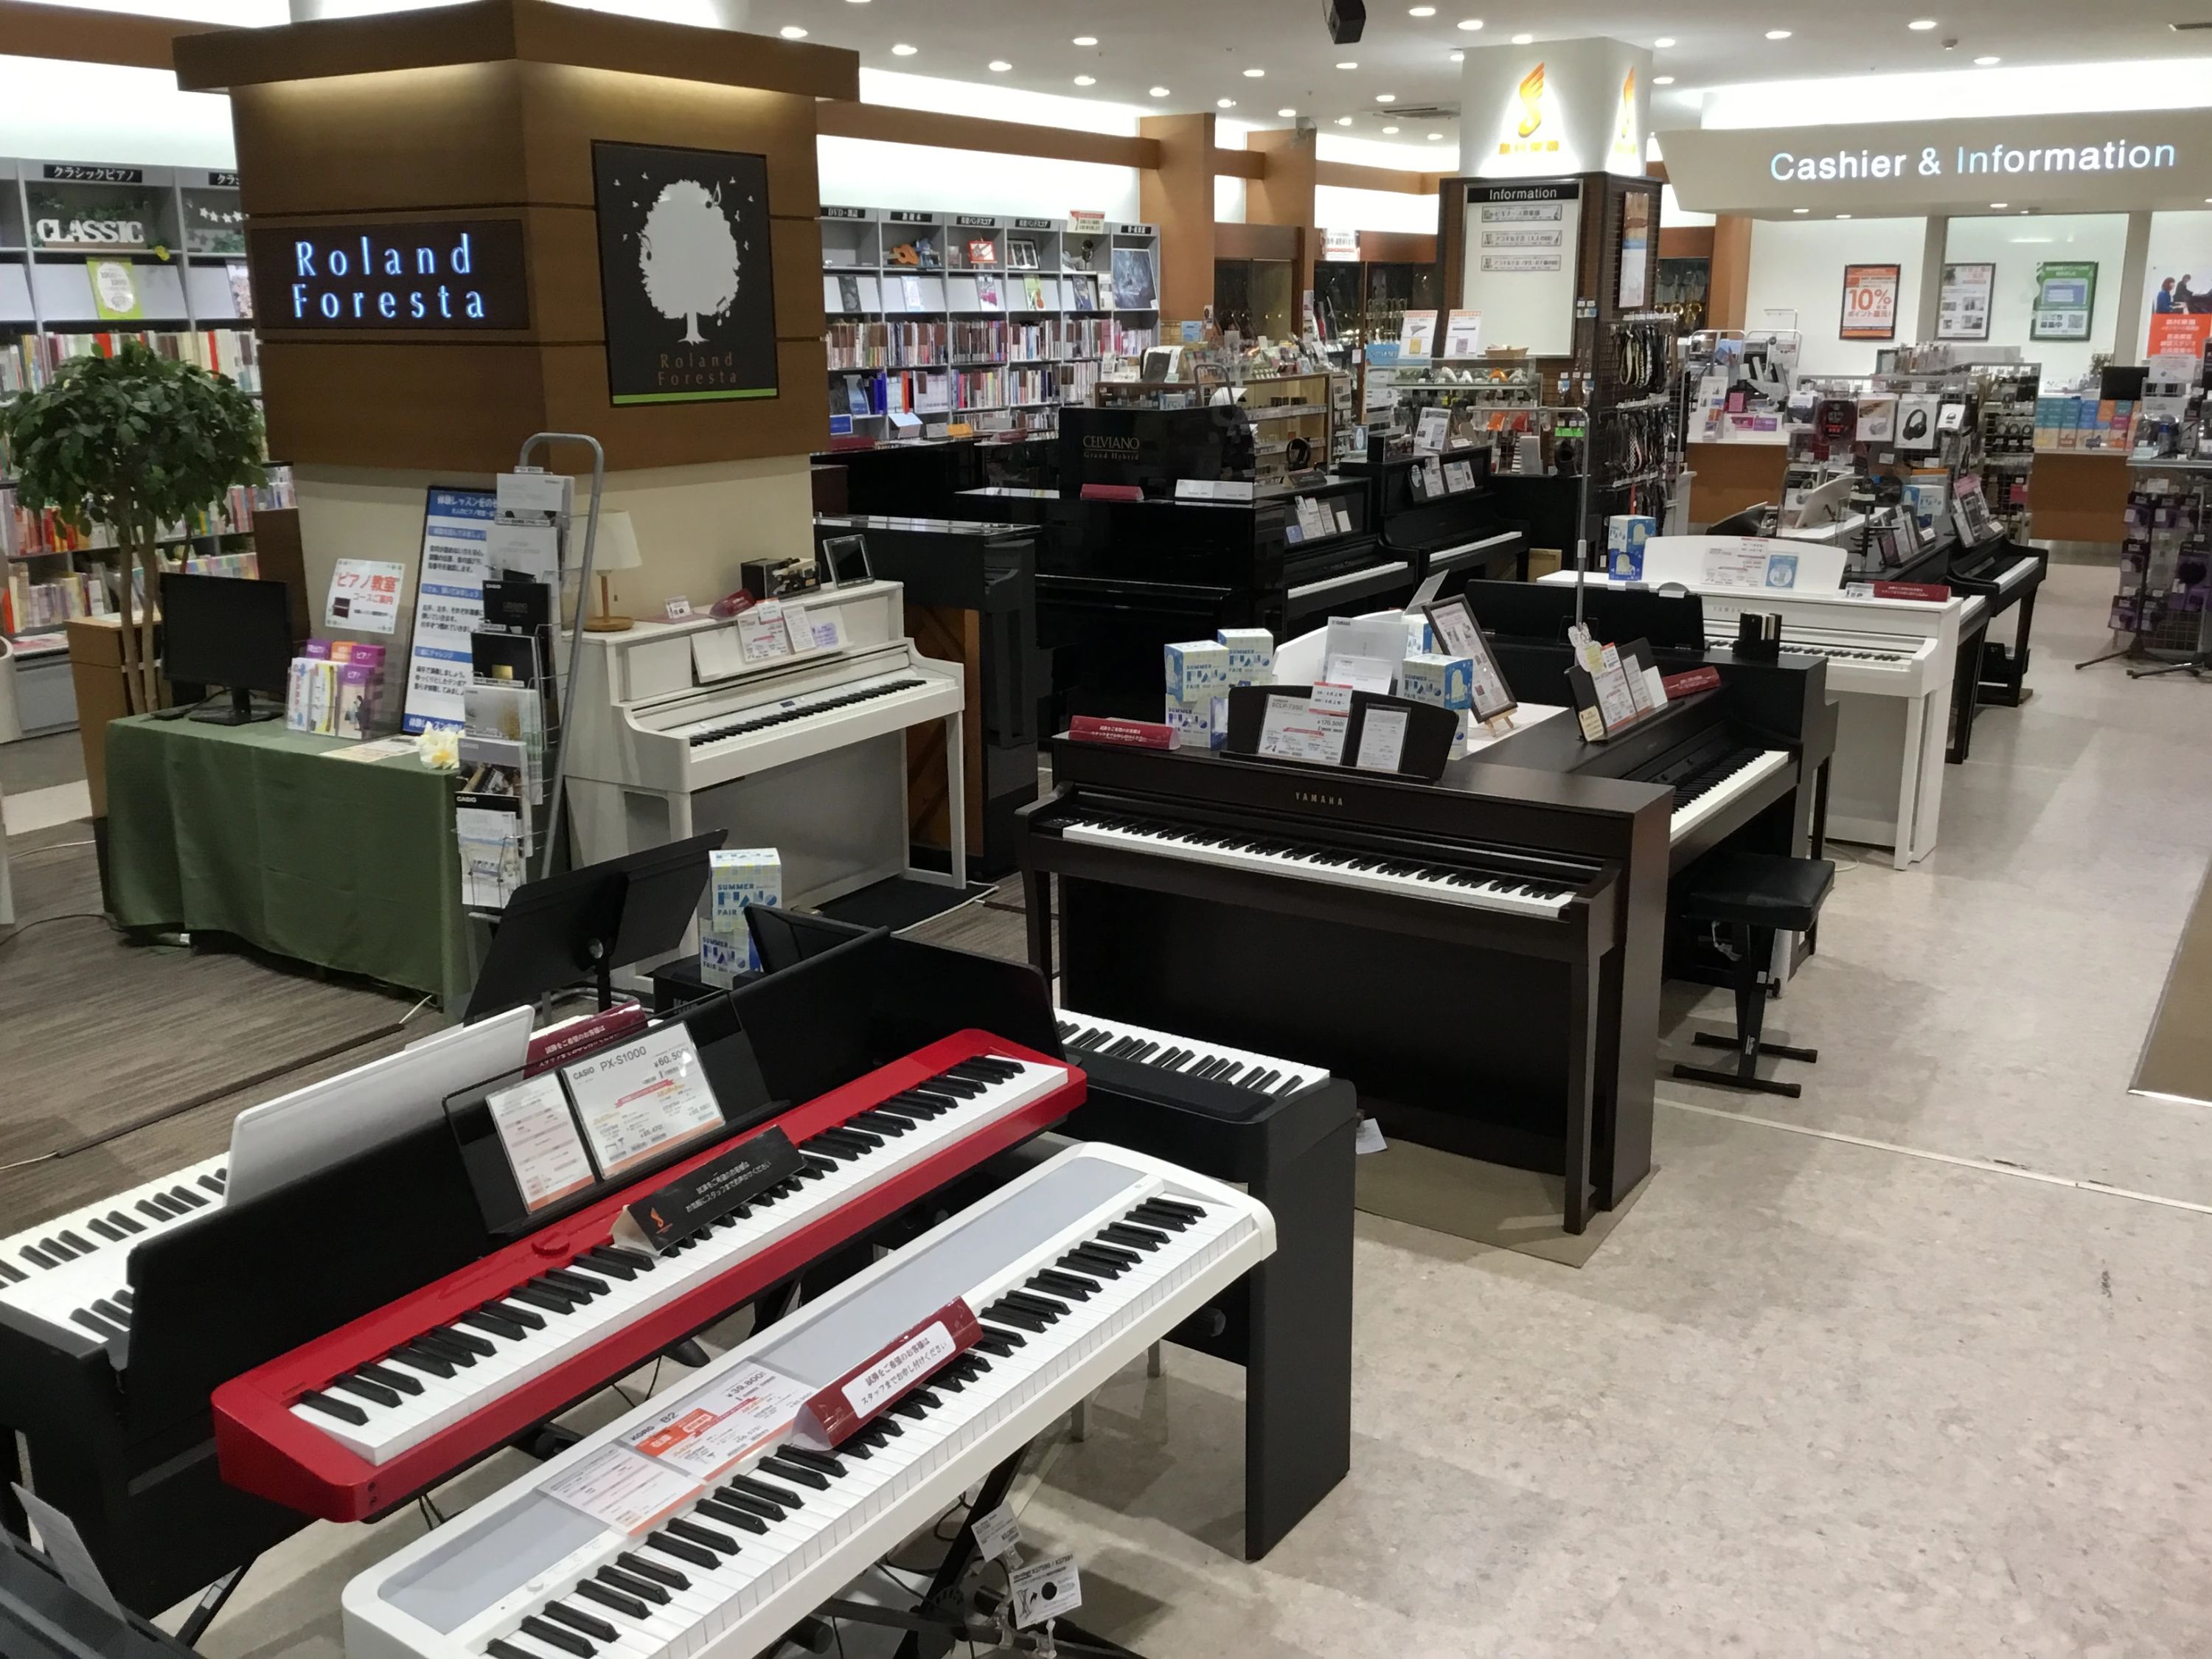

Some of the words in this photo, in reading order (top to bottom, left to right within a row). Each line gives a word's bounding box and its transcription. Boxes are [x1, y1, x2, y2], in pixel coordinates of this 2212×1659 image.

[1770, 150, 1906, 181] Cashier
[1919, 147, 1941, 176] &
[1958, 139, 2175, 175] Information
[54, 166, 134, 181] クラシックピアノ
[217, 173, 240, 185] クラ
[1489, 188, 1557, 201] Information
[37, 219, 145, 243] CLASSIC
[295, 233, 472, 277] Roland
[292, 282, 485, 319] Foresta
[1848, 288, 1892, 310] 10%
[660, 351, 733, 369] Roland
[658, 369, 737, 386] Foresta
[1083, 435, 1140, 451] CELVIANO
[1084, 451, 1107, 460] Grand
[1111, 451, 1140, 461] Hybrid
[337, 571, 397, 593] ピアノ教室
[456, 795, 477, 804] CASIO
[1295, 791, 1343, 807] YAMAHA
[717, 908, 738, 917] FAIR
[702, 936, 728, 949] SUMMER
[703, 961, 717, 970] FAIR
[573, 1065, 595, 1082] CASIO
[599, 1046, 647, 1072] PX-S1000
[864, 1335, 931, 1389] 試弾をご希望のお客様は
[860, 1339, 950, 1407] スタッフまでお申し付けください
[630, 1425, 655, 1441] KORG
[660, 1411, 678, 1424] B2
